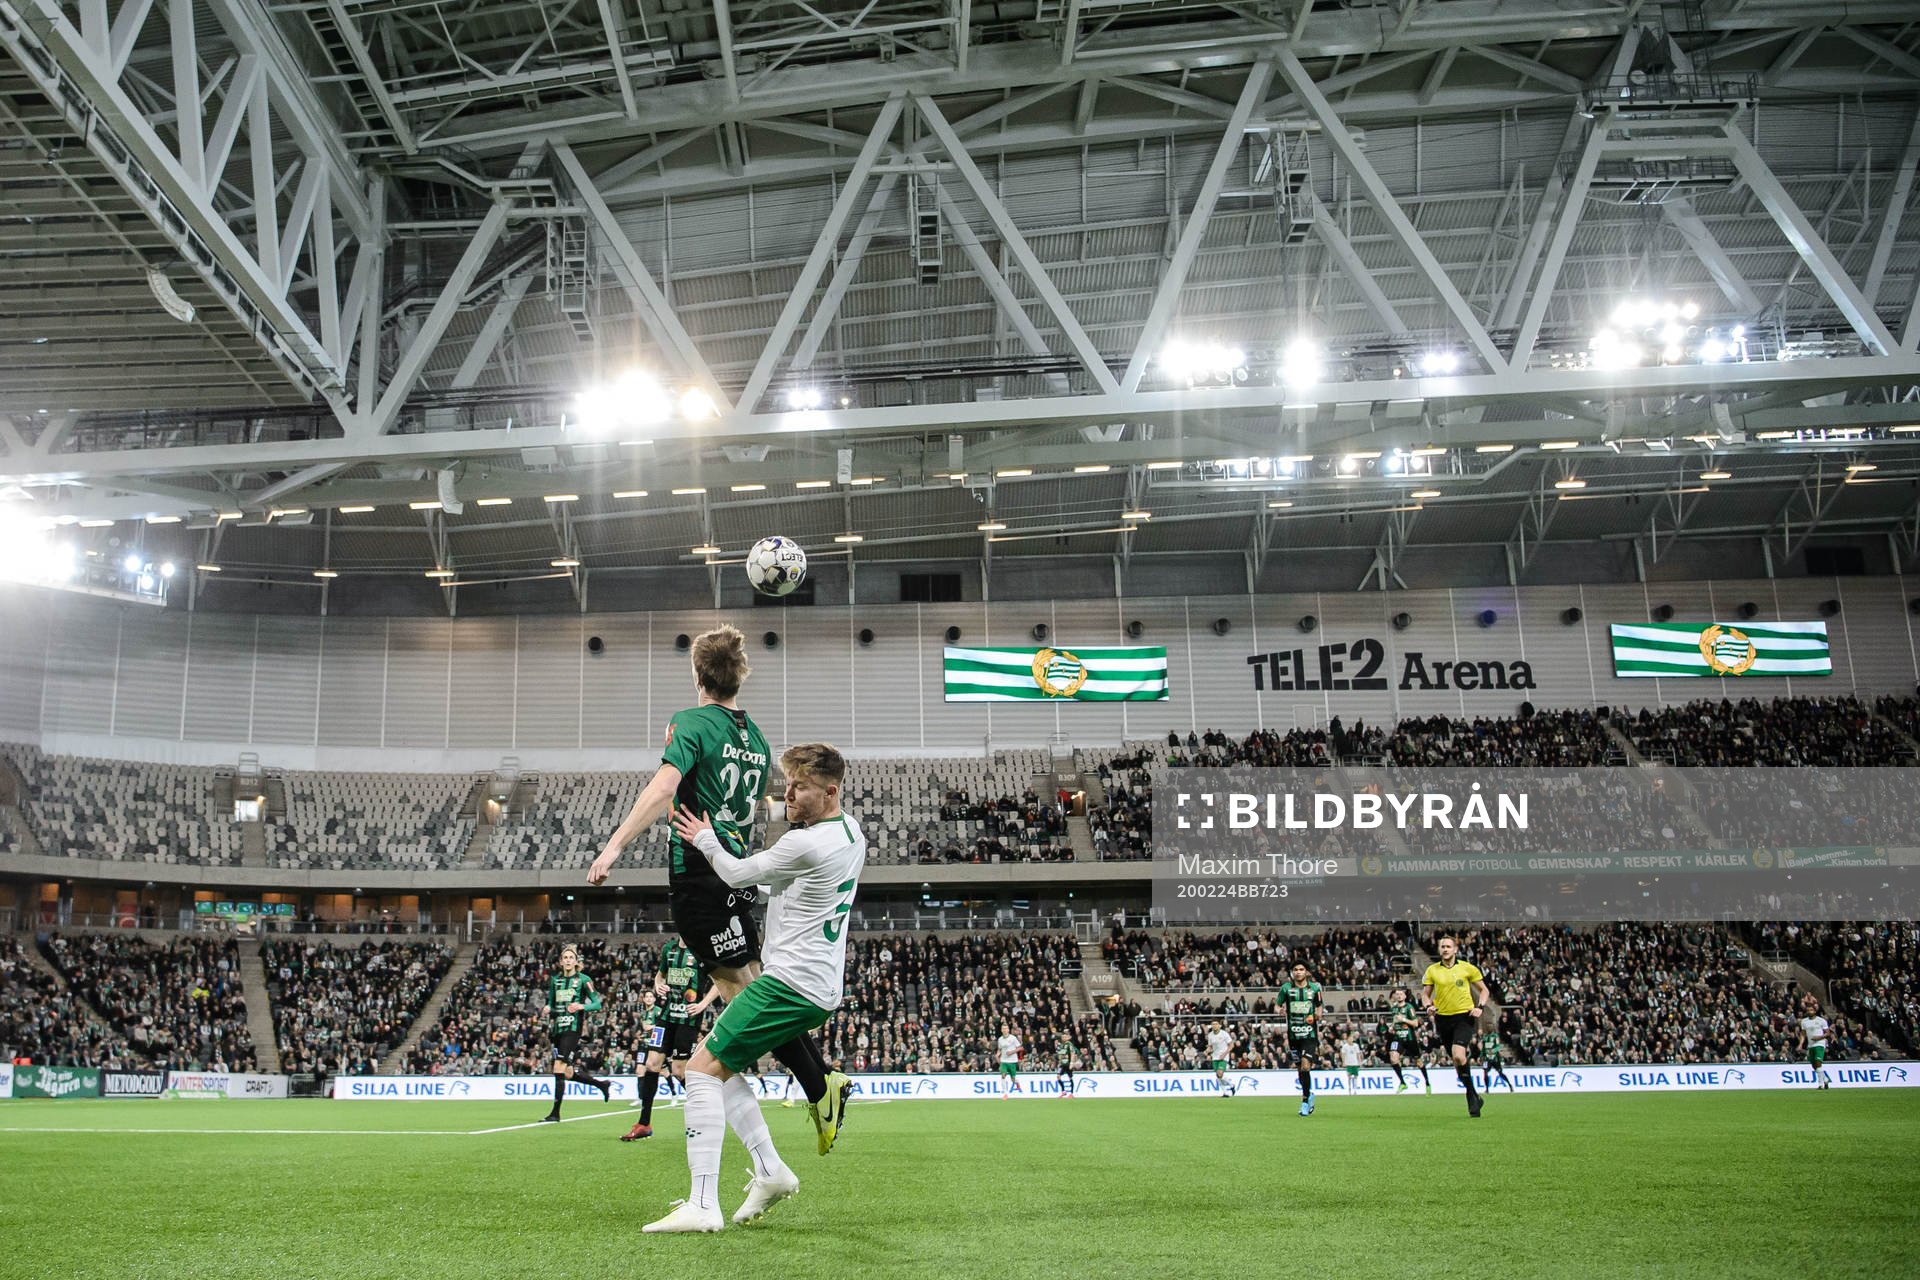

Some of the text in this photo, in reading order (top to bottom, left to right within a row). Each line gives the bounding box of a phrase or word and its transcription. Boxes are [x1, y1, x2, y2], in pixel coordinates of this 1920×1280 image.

[1247, 638, 1536, 690] TELE2 Arena
[715, 763, 761, 826] 23
[1388, 853, 1748, 872] HAMMARBY FOTBOLL GEMENSKAP RESPEKT KÄRLEK
[710, 927, 732, 945] swt
[1457, 1074, 1556, 1088] SLJA LINE
[1618, 1071, 1719, 1086] SILJA LINE
[1839, 1069, 1881, 1082] LINE
[180, 1077, 229, 1091] INTERSPORT
[352, 1083, 445, 1096] SILJA LINE
[504, 1083, 598, 1096] SILJA INE
[871, 1081, 912, 1094] LINE
[974, 1081, 1022, 1094] SILA
[1134, 1079, 1183, 1092] SILJA
[1295, 1077, 1344, 1090] SLJA
